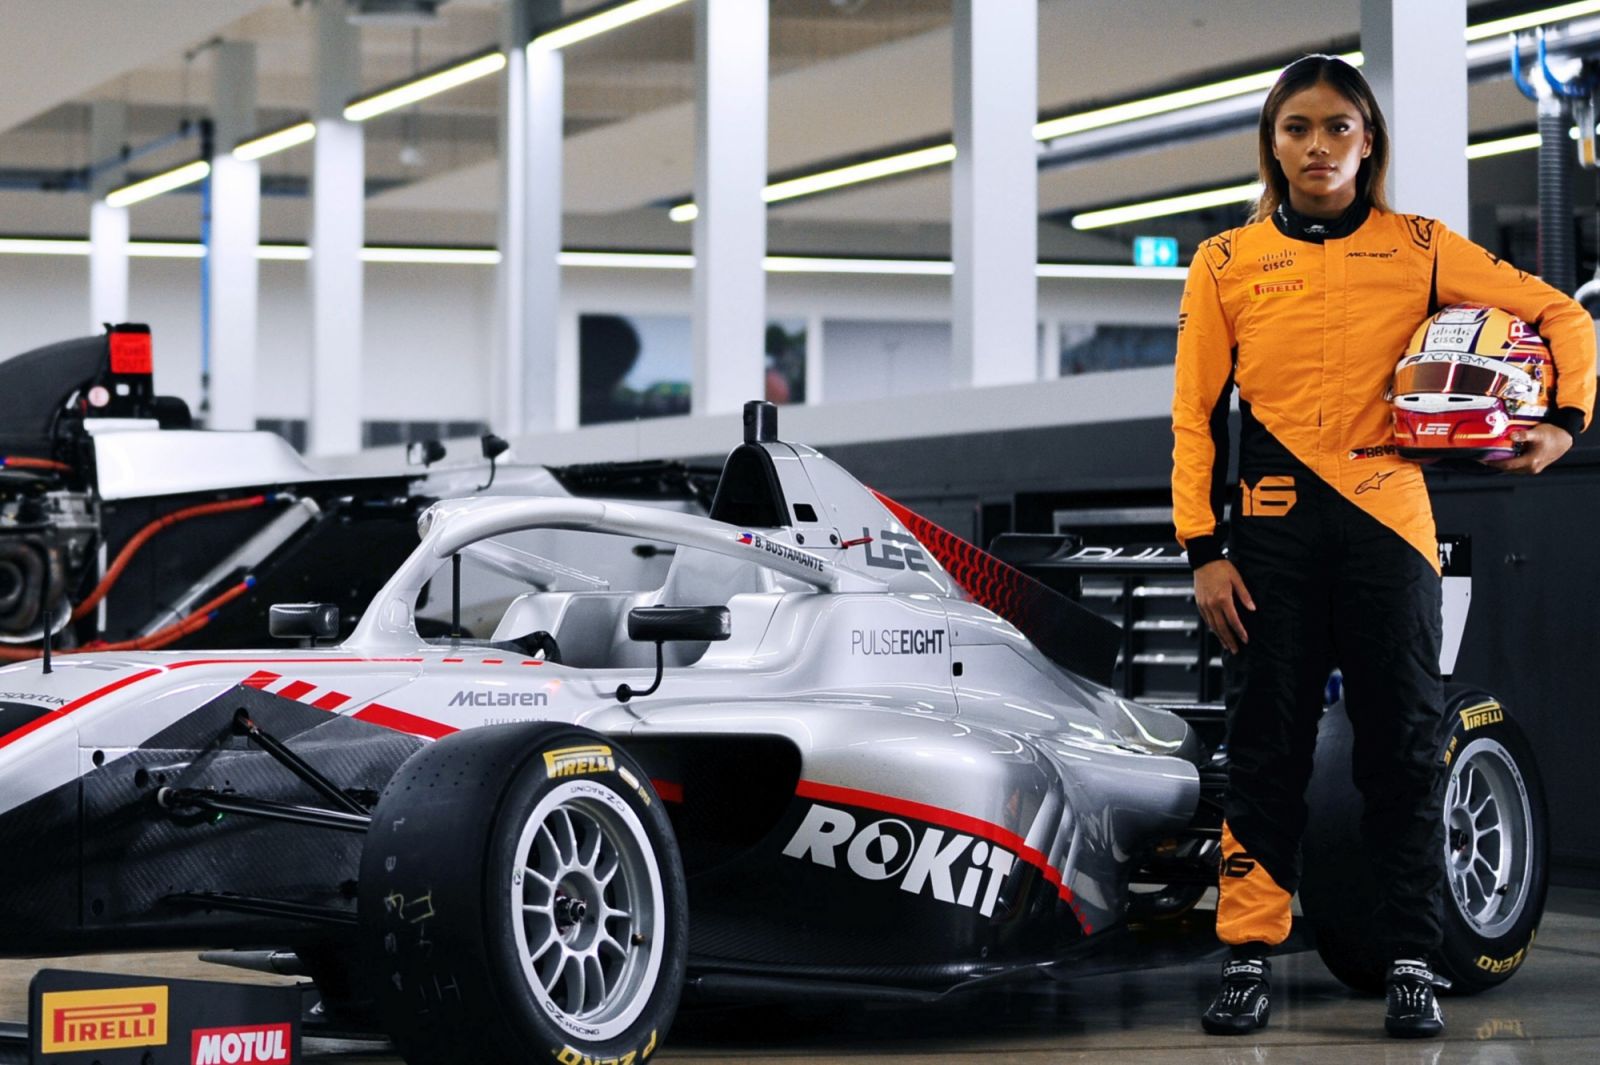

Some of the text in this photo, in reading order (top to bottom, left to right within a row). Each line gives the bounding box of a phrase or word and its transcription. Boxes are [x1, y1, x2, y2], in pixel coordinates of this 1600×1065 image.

[1263, 259, 1294, 272] CISCO
[1254, 279, 1303, 295] PIRELLI
[1433, 336, 1464, 344] CISCO
[1416, 423, 1451, 435] LEE
[1240, 476, 1297, 516] 16
[755, 536, 824, 572] B. BUSTAMANTE
[863, 527, 930, 572] LEE
[852, 630, 945, 655] PULSEEIGHT
[0, 692, 70, 706] sportuk
[448, 691, 548, 706] McLaren
[1459, 702, 1503, 731] PIRELLI
[543, 745, 615, 778] PIRELLI
[1476, 948, 1524, 973] ZERO
[53, 1002, 156, 1043] PIRELLI
[196, 1029, 286, 1065] MOTUL
